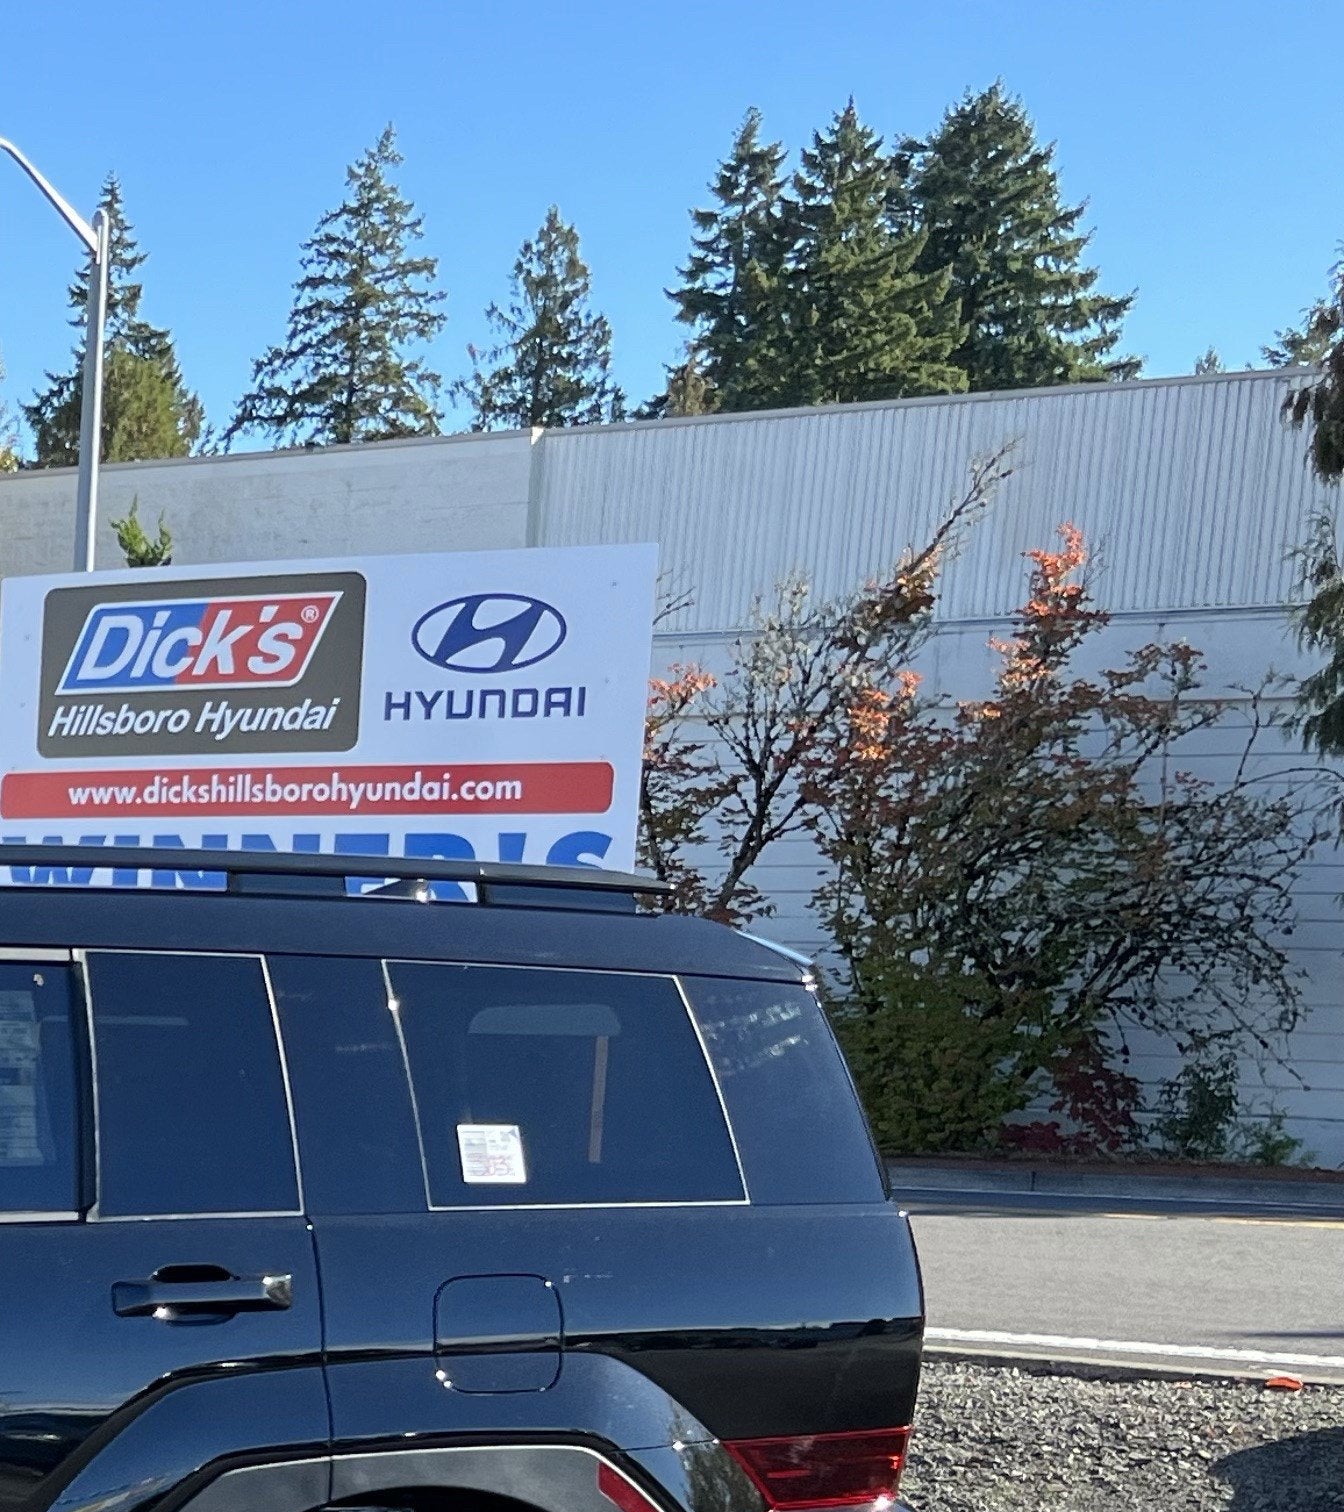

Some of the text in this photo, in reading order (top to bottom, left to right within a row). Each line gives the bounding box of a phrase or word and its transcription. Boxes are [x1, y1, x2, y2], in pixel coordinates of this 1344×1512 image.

[48, 697, 342, 740] Hillsboro Hyundai
[383, 686, 587, 721] HYUNDAI
[68, 772, 522, 809] www.dickshillsborohyundai.com
